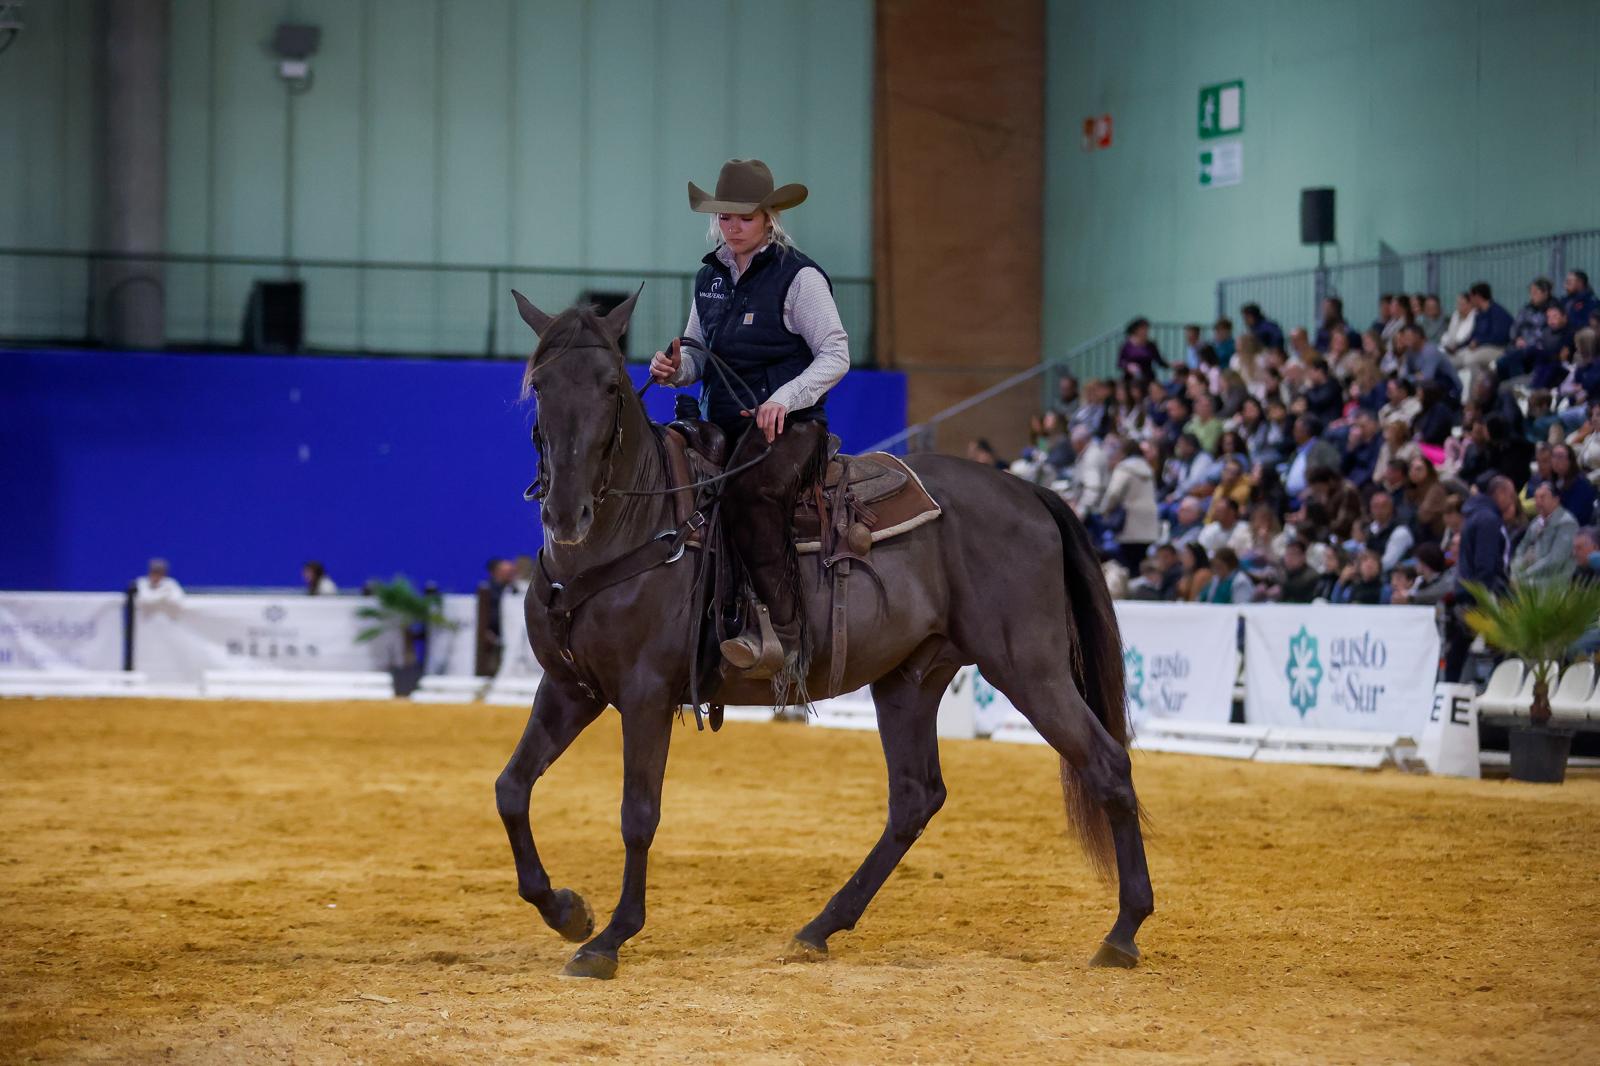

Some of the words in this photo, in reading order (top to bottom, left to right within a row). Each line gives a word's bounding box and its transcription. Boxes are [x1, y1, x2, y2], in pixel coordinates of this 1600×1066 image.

[1149, 650, 1190, 688] gusto
[1329, 630, 1387, 683] gusto
[1159, 681, 1188, 712] Sur
[1345, 671, 1386, 714] Sur
[1430, 695, 1444, 722] E
[1450, 696, 1471, 726] E
